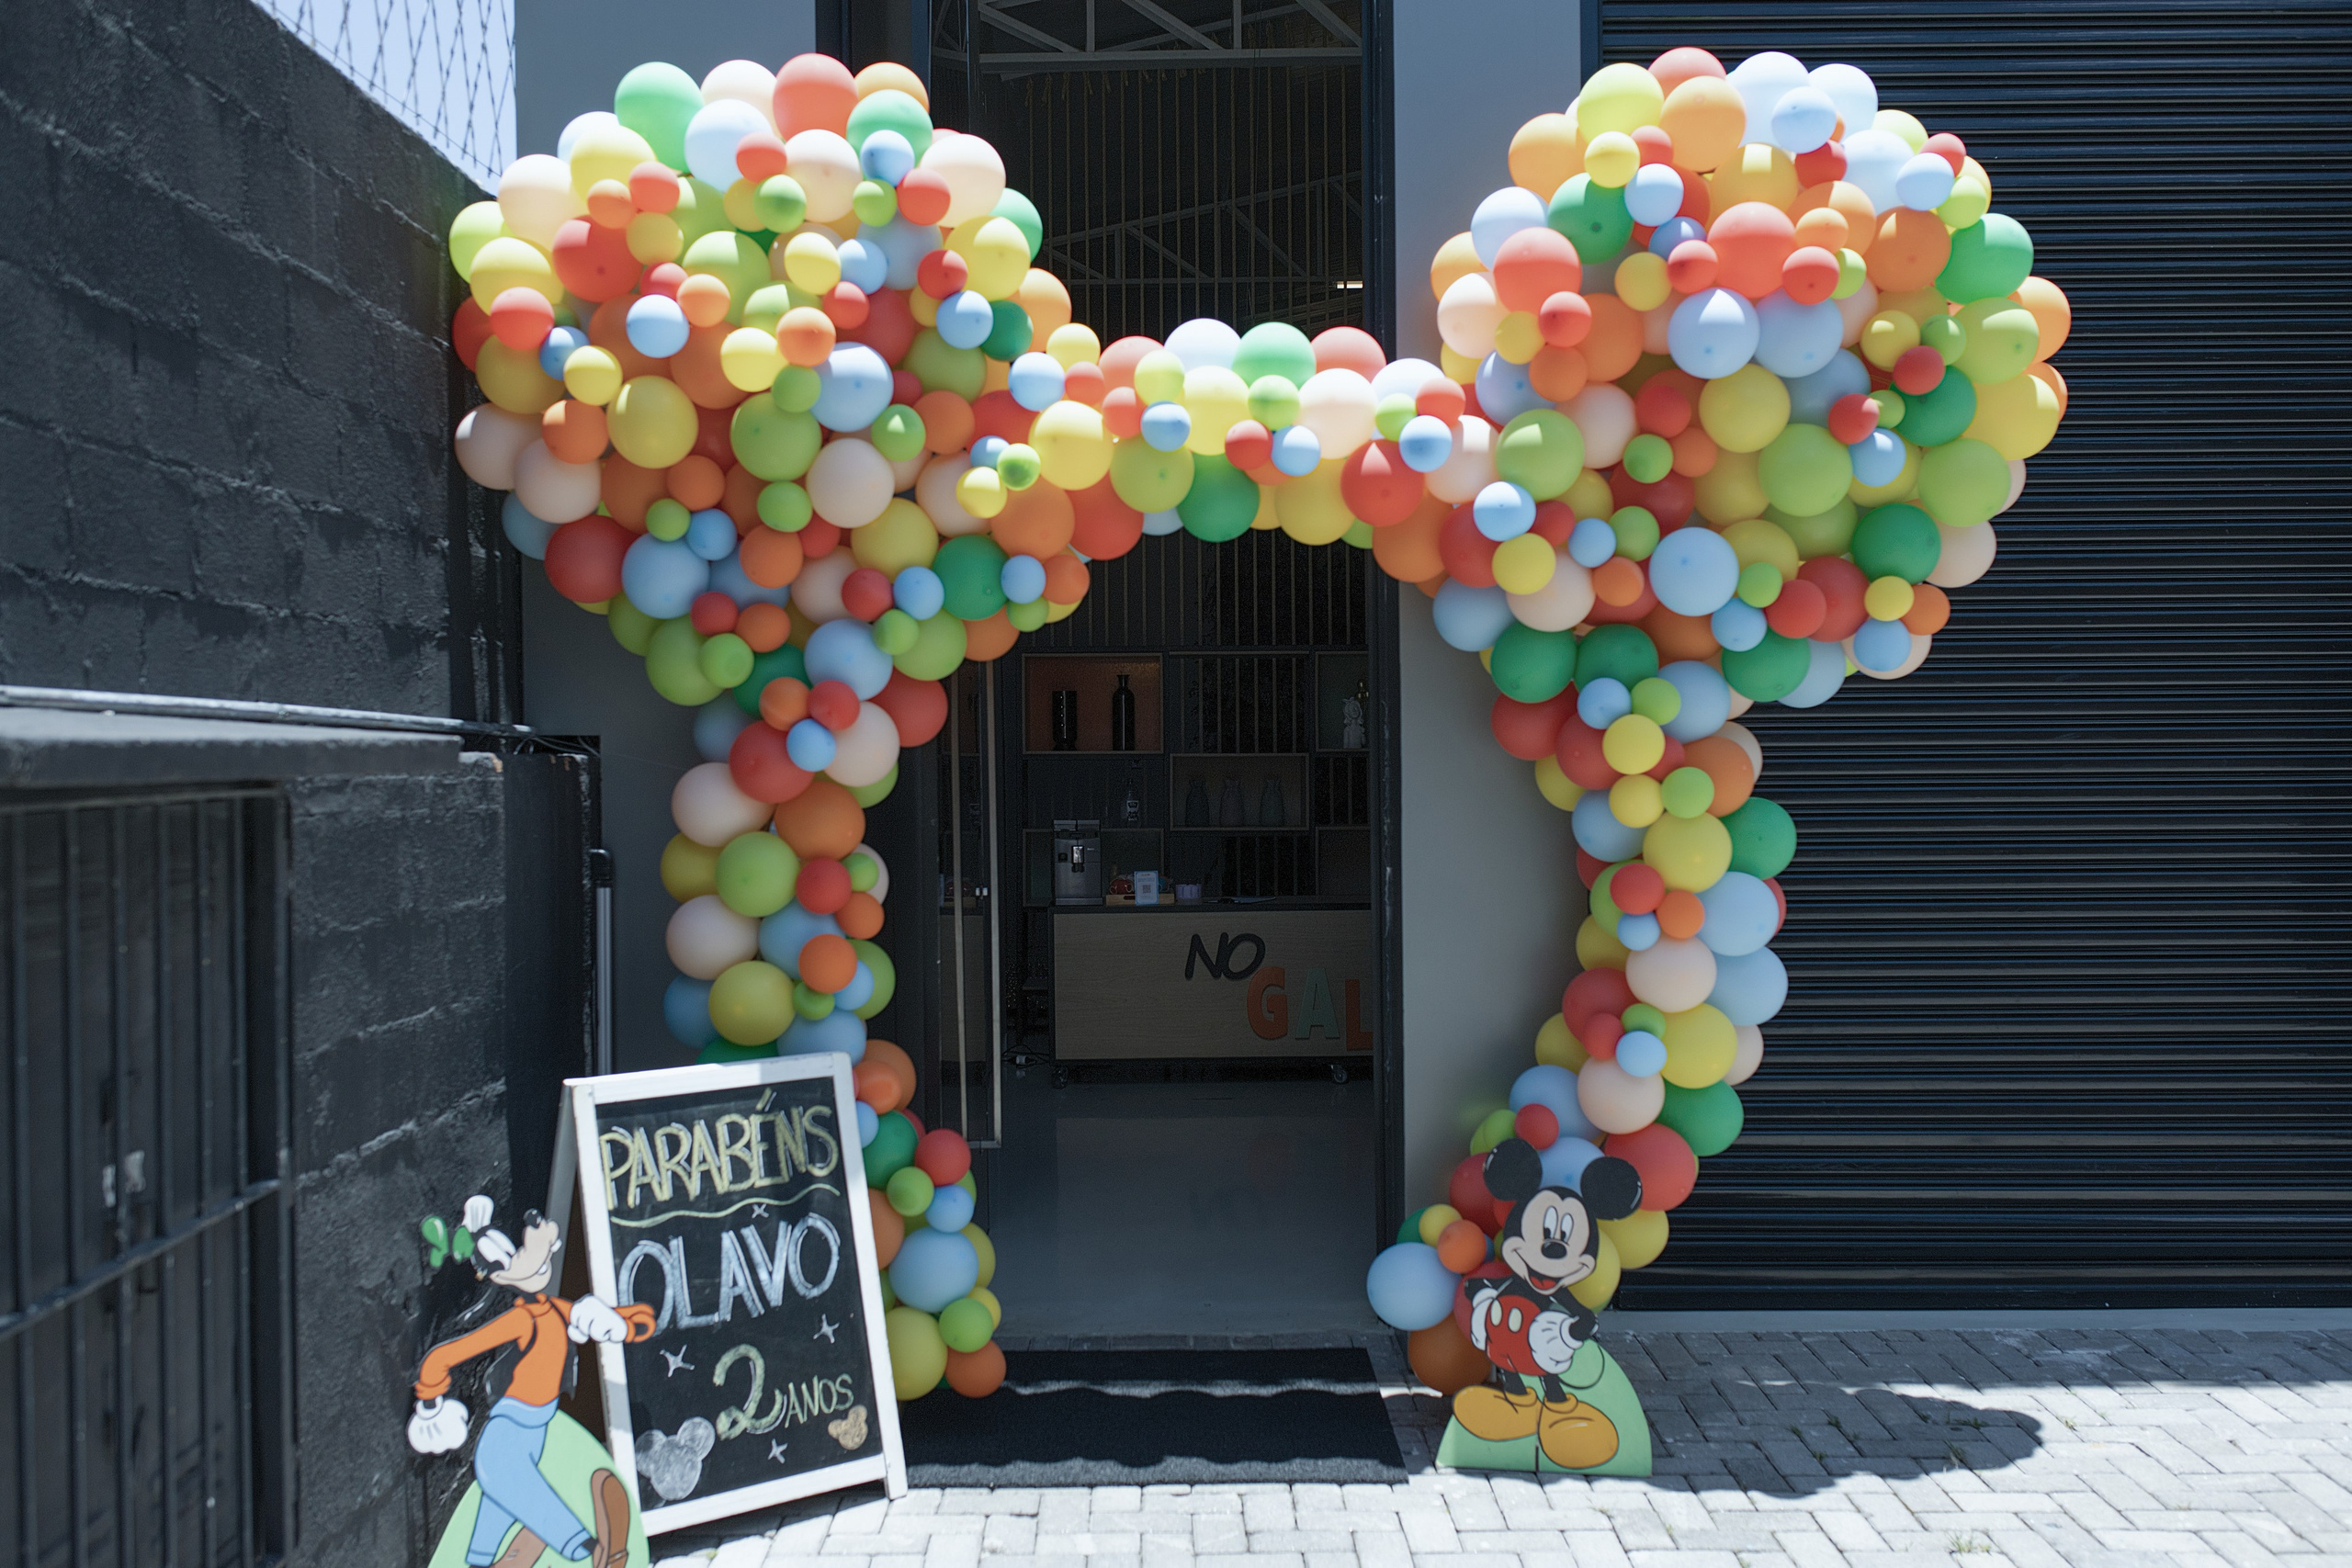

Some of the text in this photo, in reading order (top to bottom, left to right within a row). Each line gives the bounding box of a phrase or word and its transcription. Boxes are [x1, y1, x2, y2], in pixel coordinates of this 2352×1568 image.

[1185, 932, 1266, 980] NO
[1247, 965, 1373, 1051] GAL
[600, 1089, 838, 1209] PARABÉNS
[618, 1213, 840, 1337] OLAVO
[713, 1343, 854, 1439] 2 ANOS
